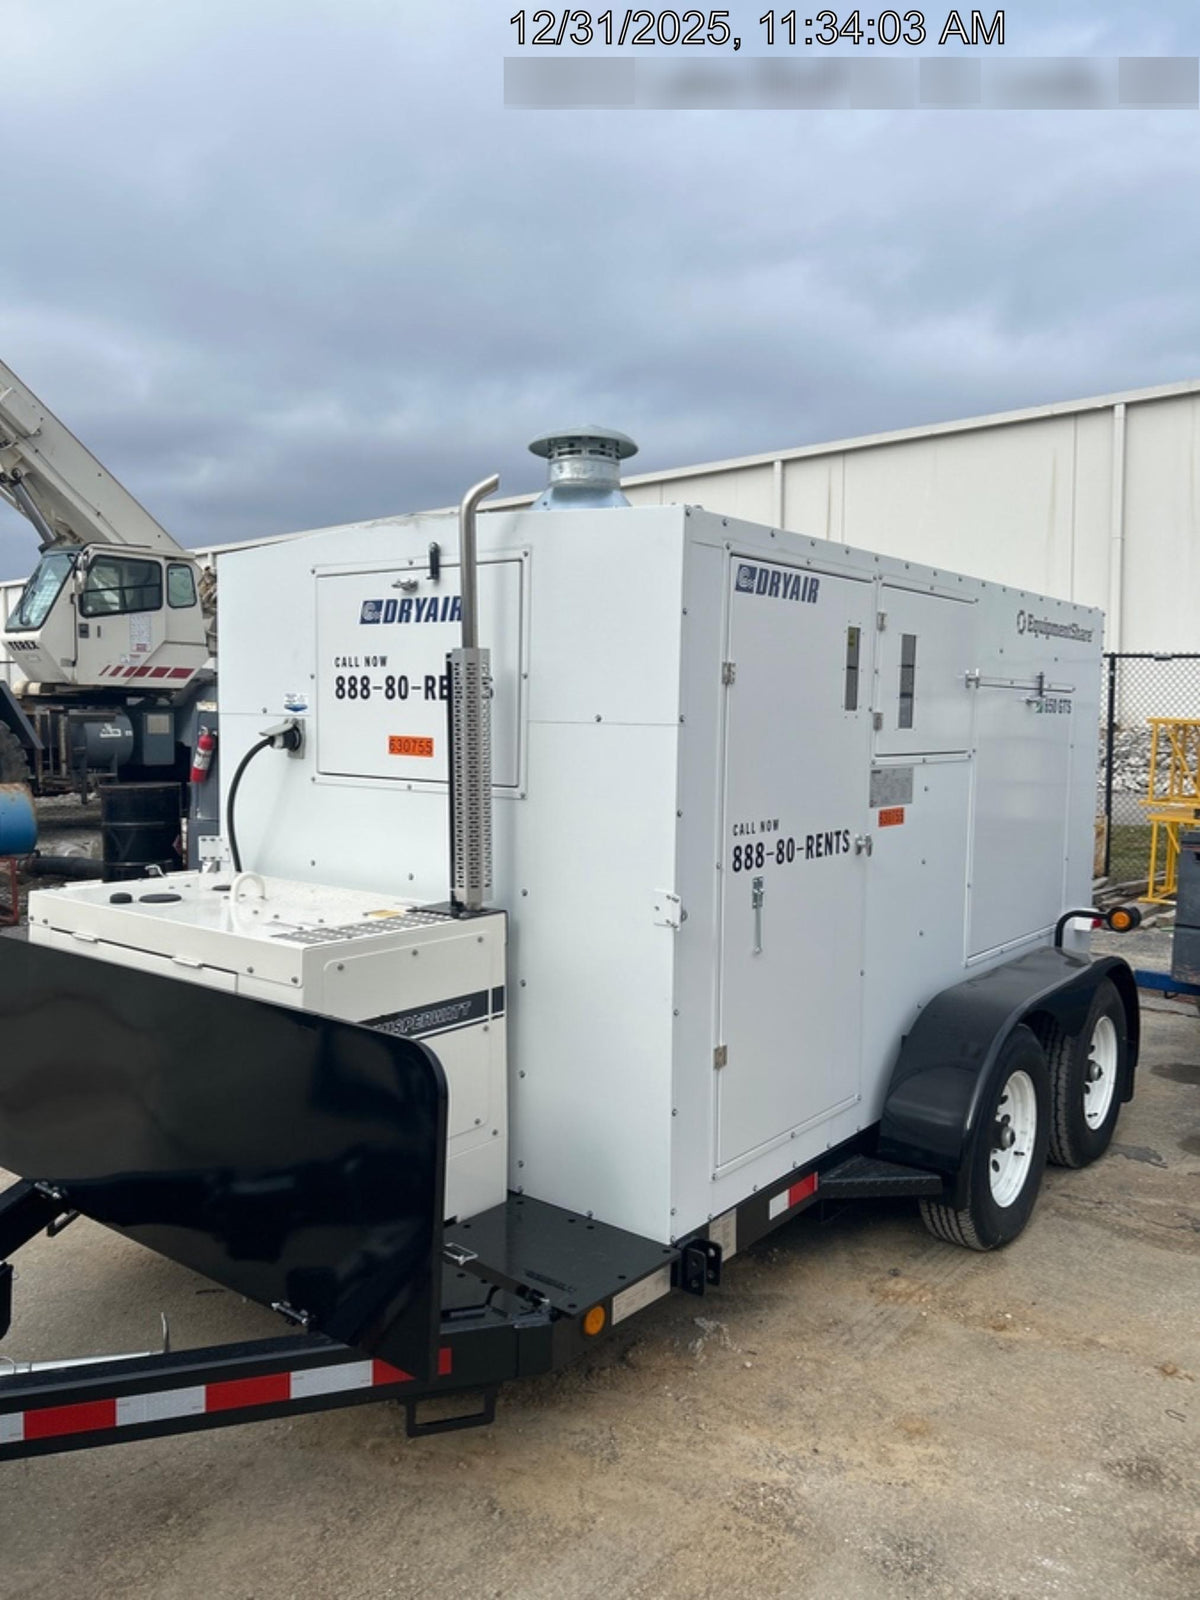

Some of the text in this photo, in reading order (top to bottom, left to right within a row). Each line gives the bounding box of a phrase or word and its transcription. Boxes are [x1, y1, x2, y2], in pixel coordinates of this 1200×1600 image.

[755, 568, 820, 604] DRYAIR
[1028, 614, 1092, 642] EquipmentShare
[334, 655, 388, 668] CALL NOW
[733, 819, 779, 836] CALL NOW
[732, 829, 851, 872] 888-80-RENTS
